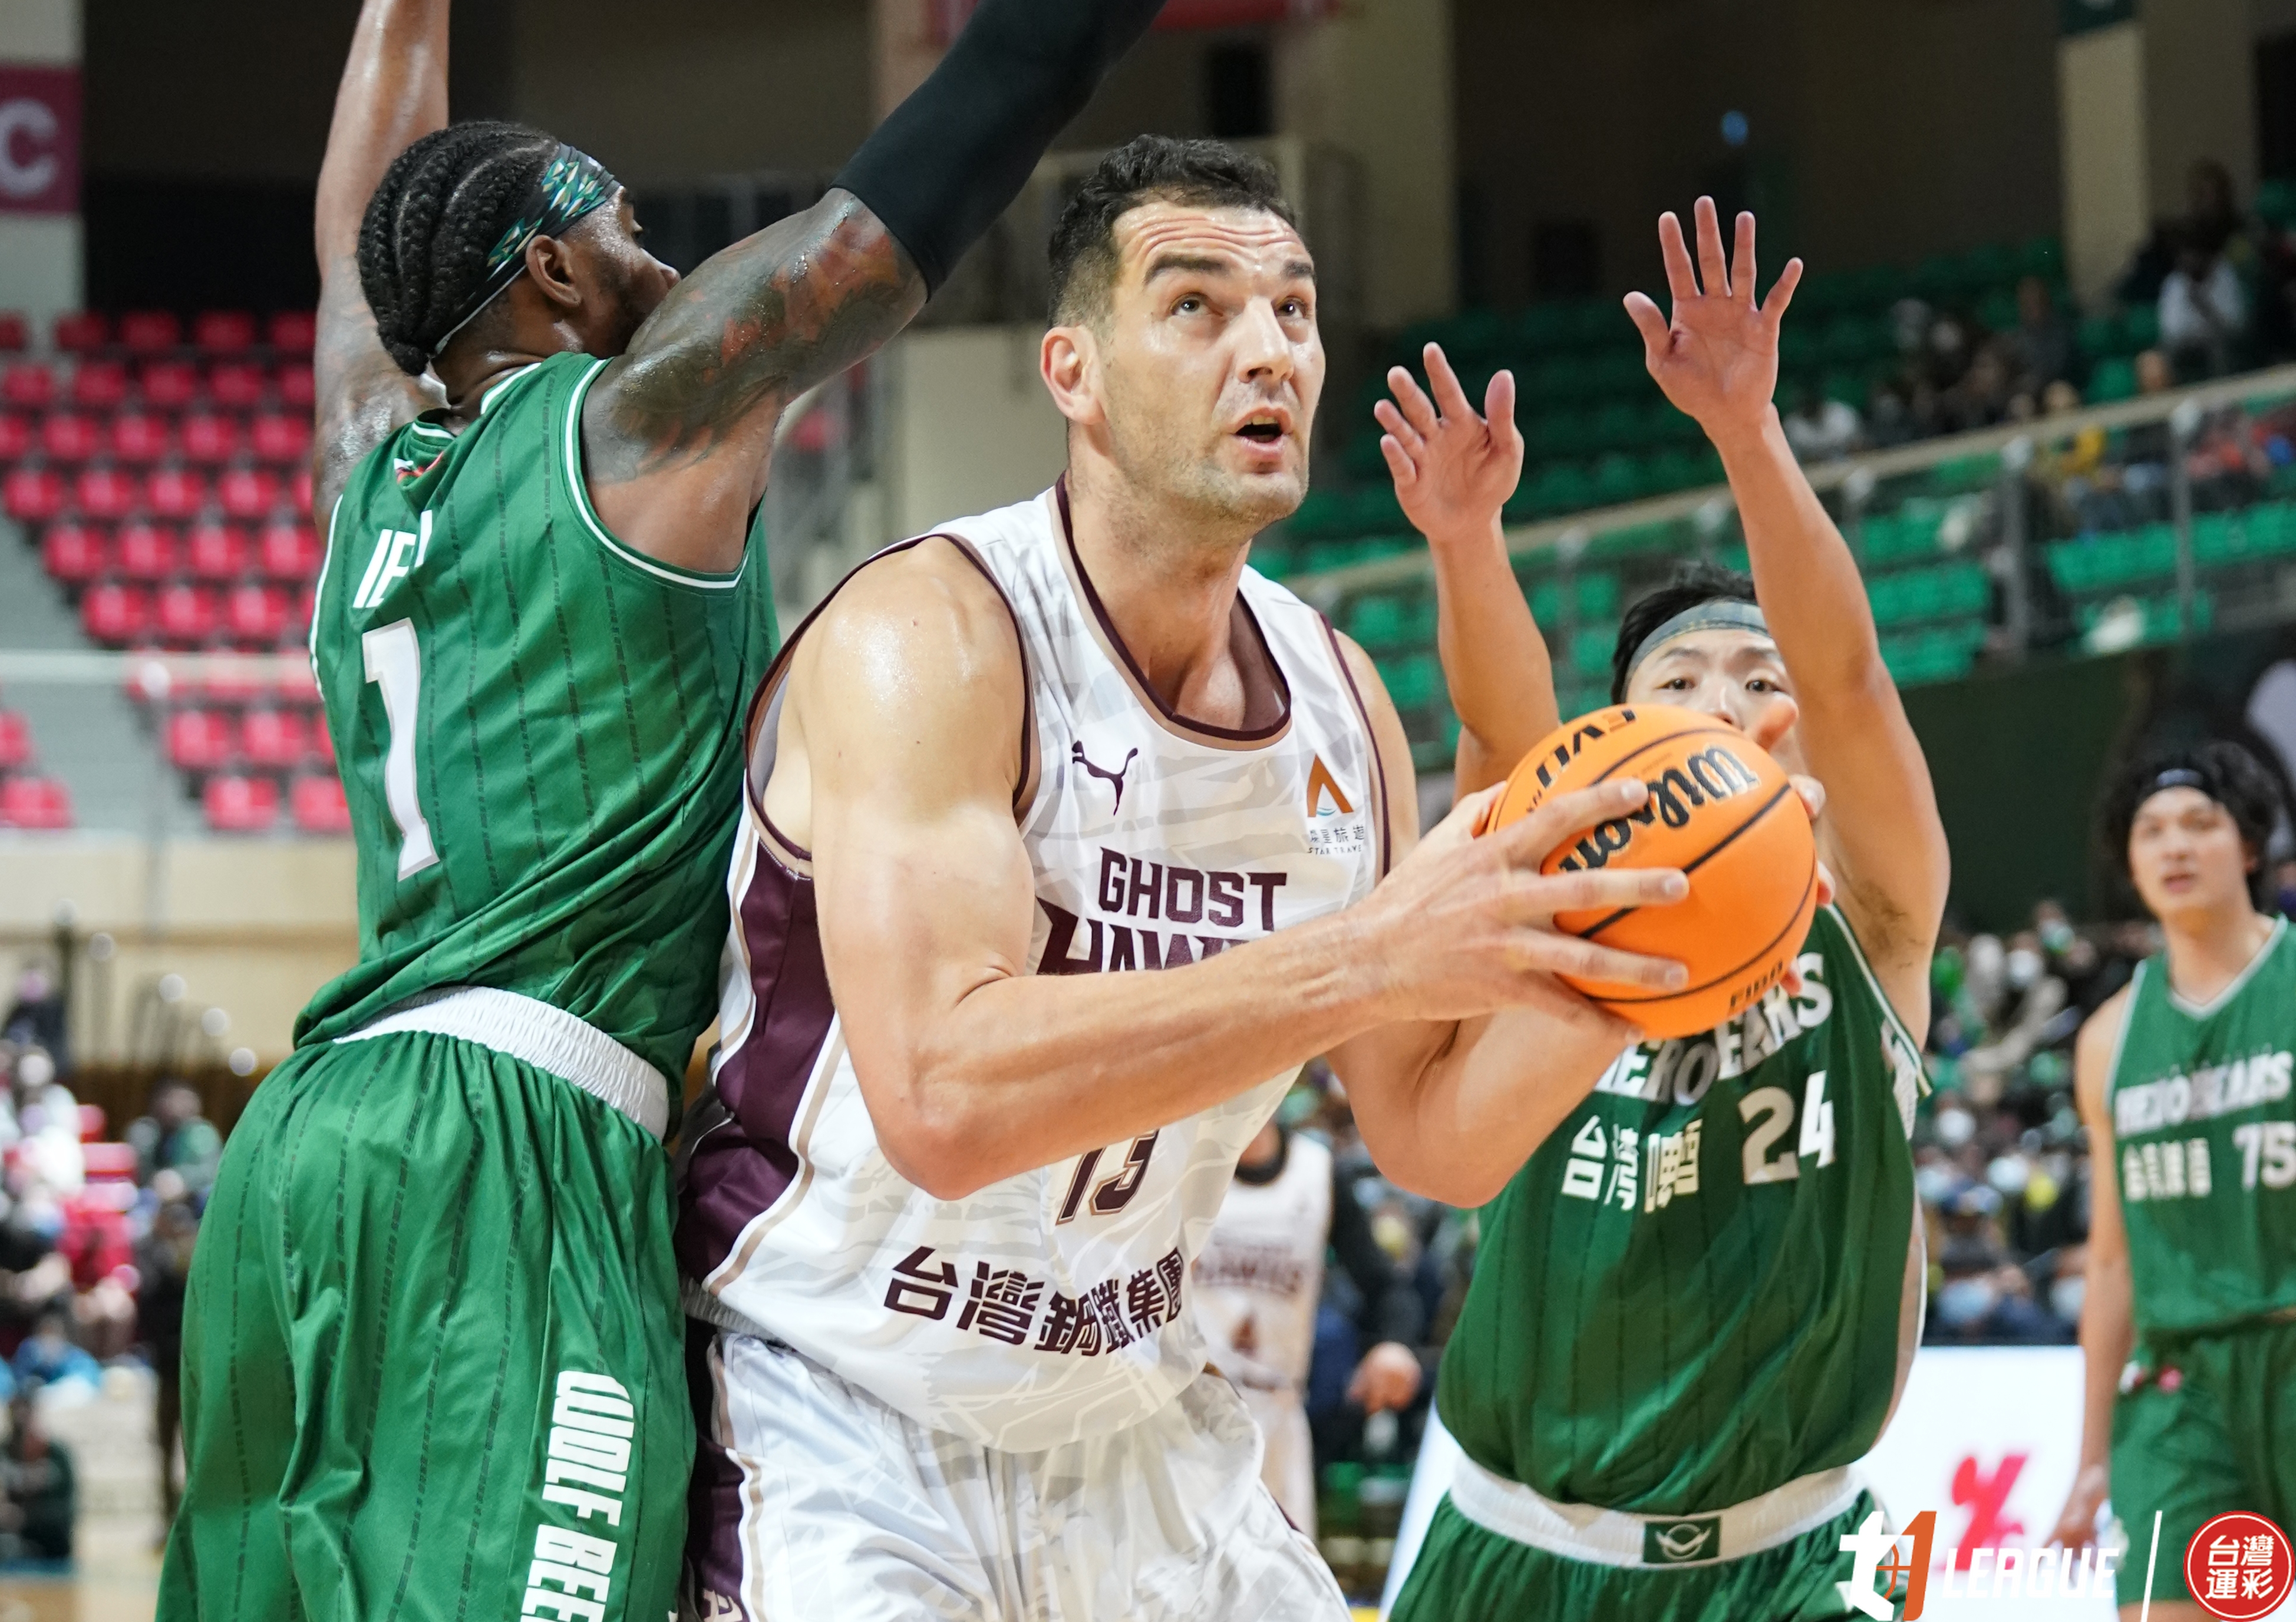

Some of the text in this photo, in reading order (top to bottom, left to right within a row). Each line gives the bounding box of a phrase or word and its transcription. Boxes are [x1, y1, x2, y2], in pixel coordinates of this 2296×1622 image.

[362, 617, 440, 882] 1
[1100, 847, 1287, 932] GHOST
[1307, 844, 1361, 855] STAR TRAVE
[1035, 896, 1251, 976] HAW
[1738, 1070, 1836, 1185] 24
[2232, 1121, 2296, 1190] 75
[520, 1370, 635, 1622] WOLF BEE
